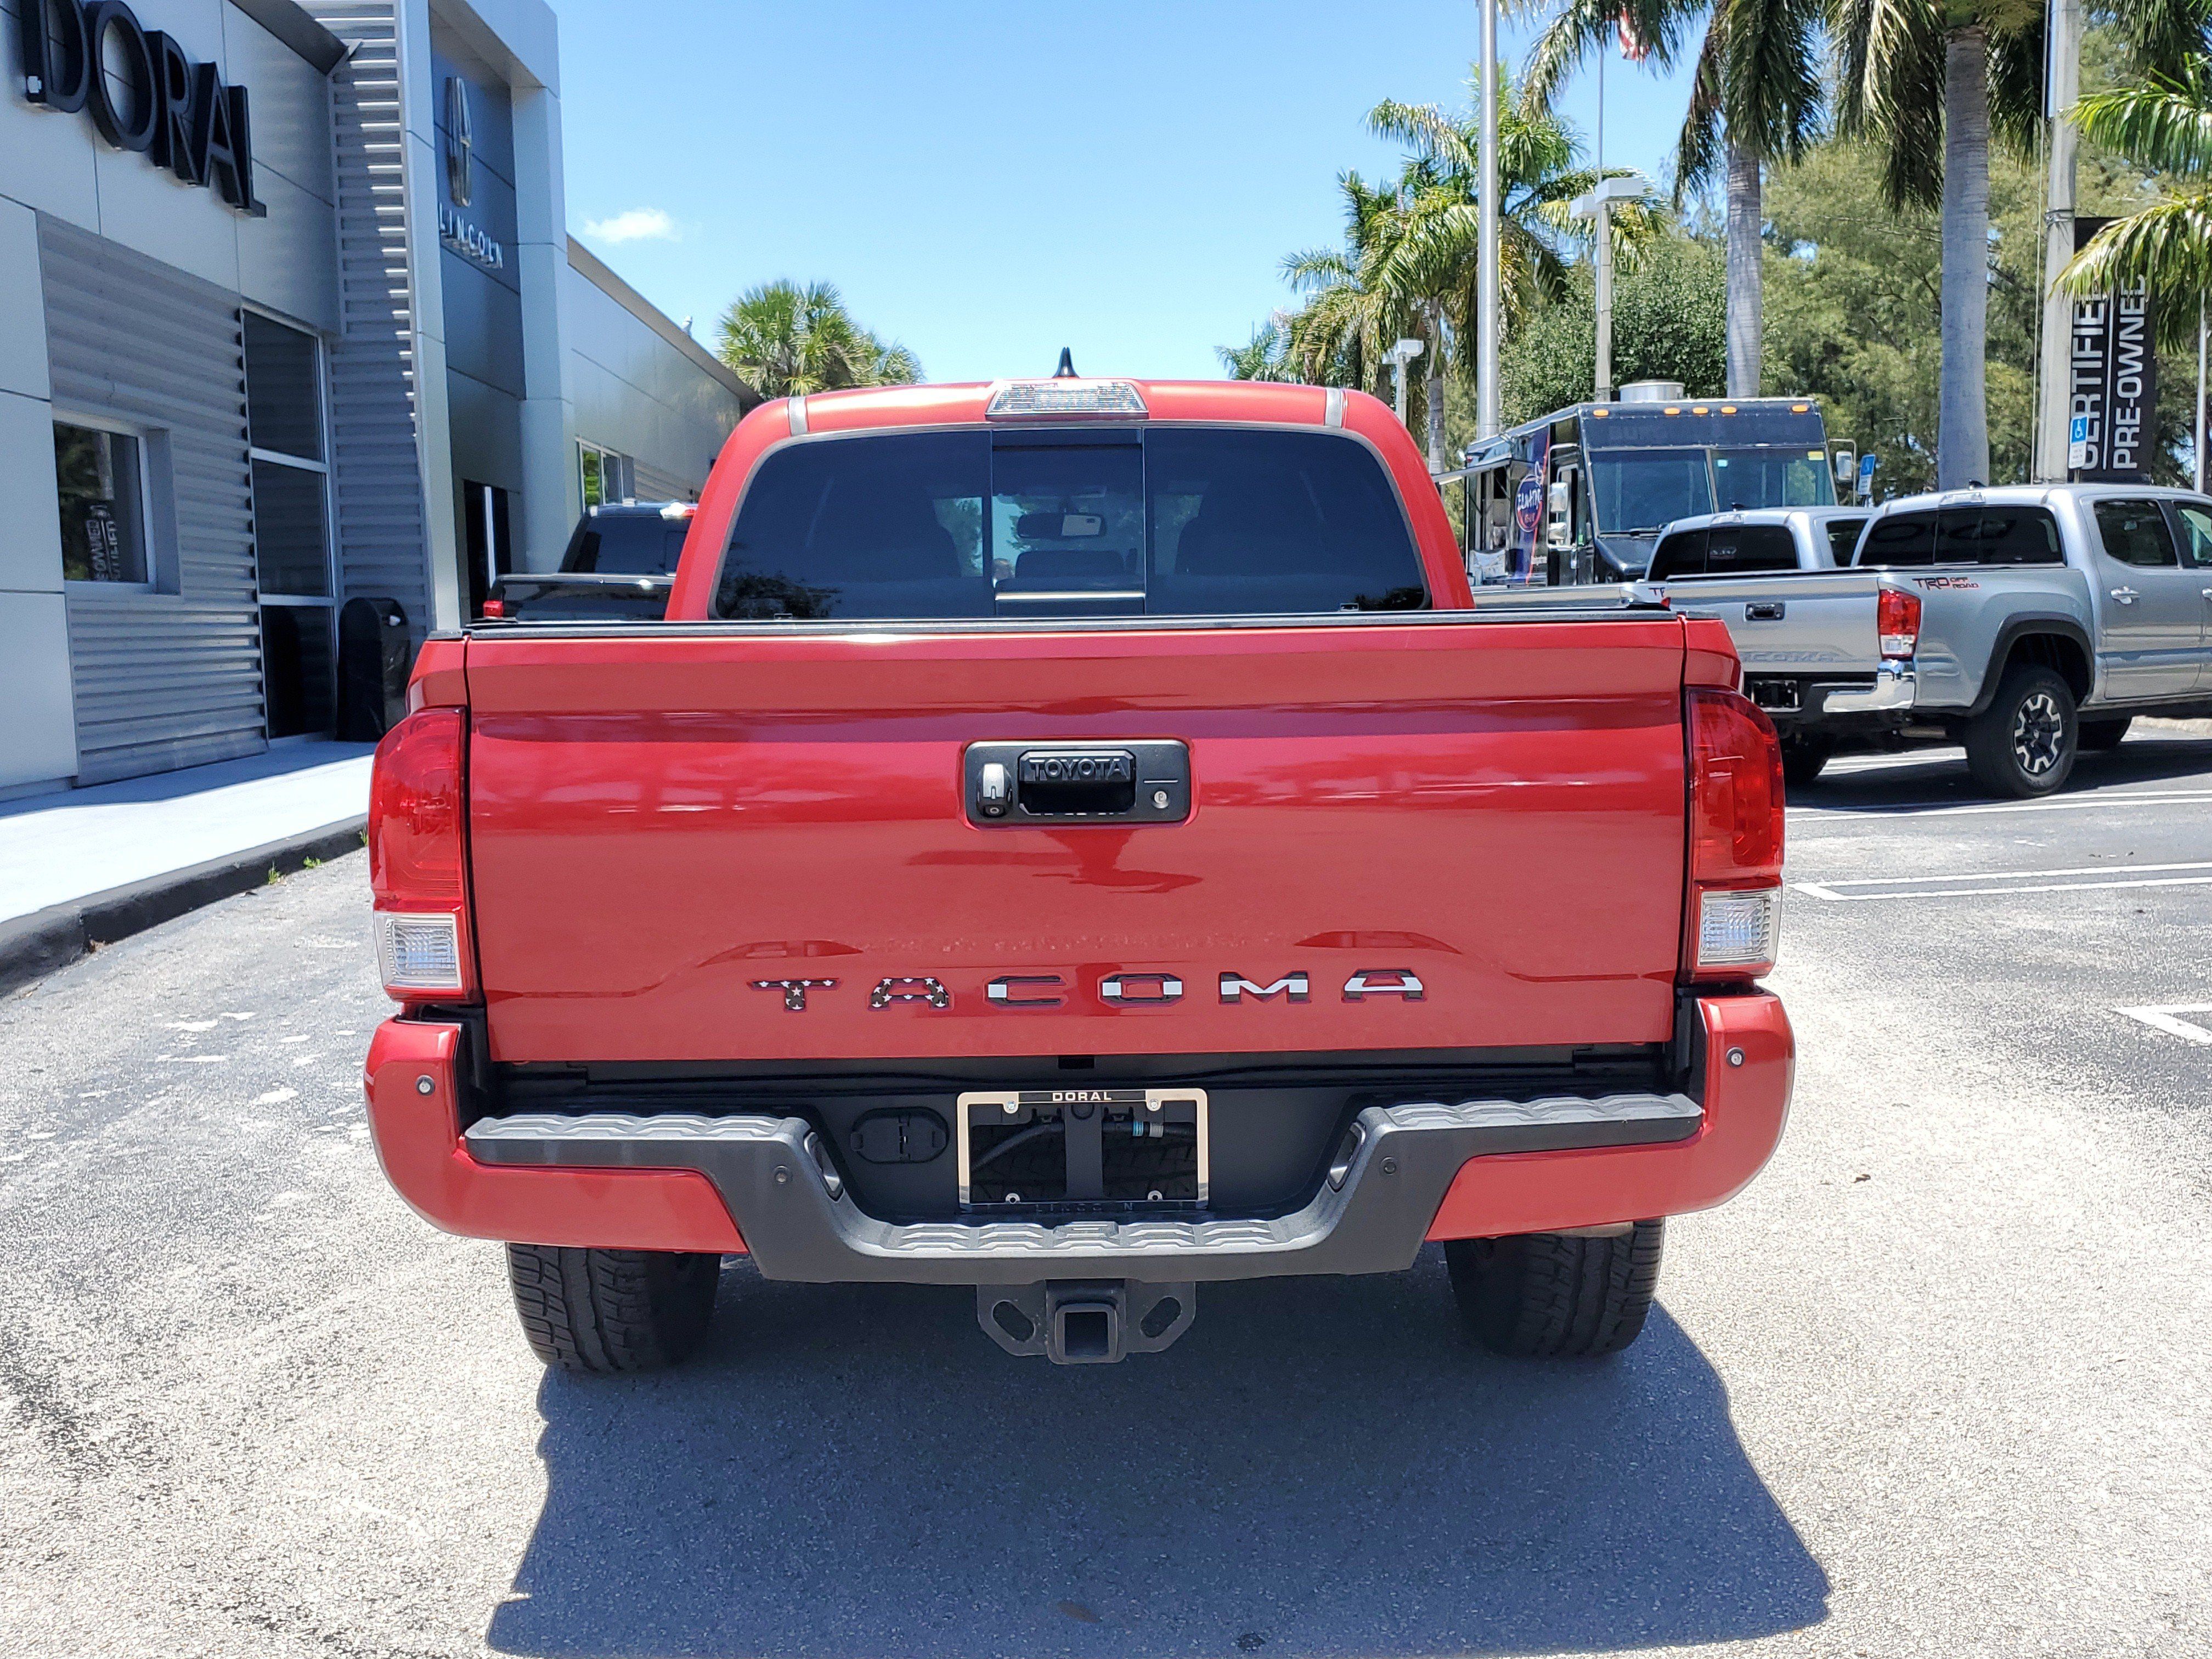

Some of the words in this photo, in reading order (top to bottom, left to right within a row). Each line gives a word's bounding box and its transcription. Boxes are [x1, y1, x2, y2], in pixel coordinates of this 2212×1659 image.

[21, 0, 267, 218] DORAL
[439, 202, 503, 269] LINCOLN
[1911, 577, 1950, 591] TRD
[1739, 650, 1838, 663] ACOMA
[1028, 758, 1130, 781] TOYOTA
[750, 968, 1426, 1011] TACOMA
[1052, 1091, 1113, 1102] DORAL
